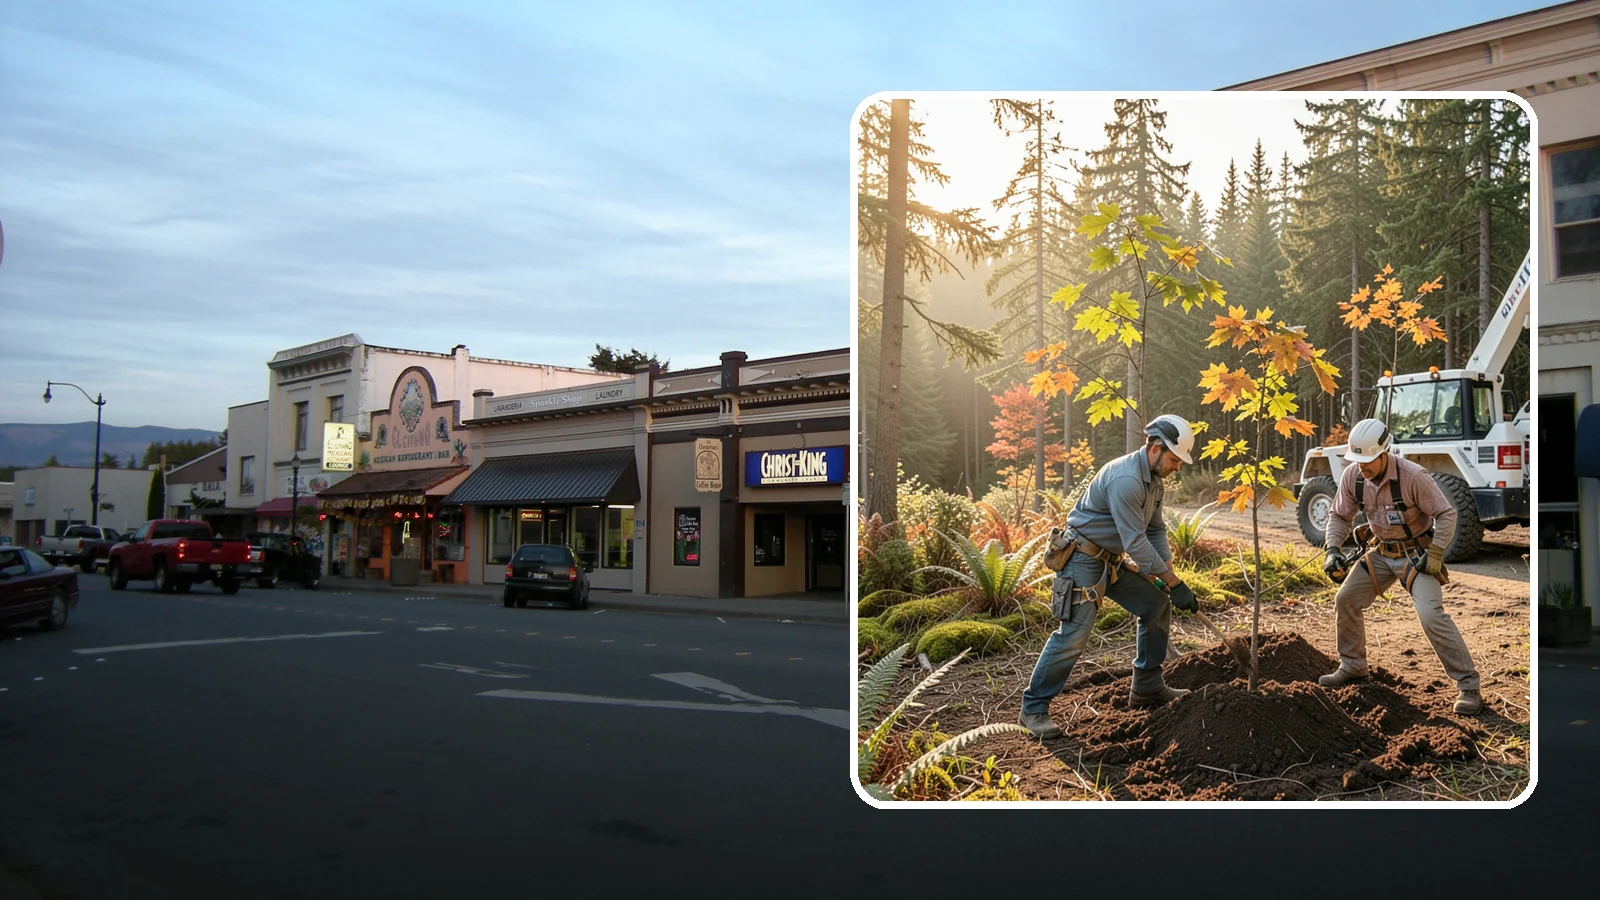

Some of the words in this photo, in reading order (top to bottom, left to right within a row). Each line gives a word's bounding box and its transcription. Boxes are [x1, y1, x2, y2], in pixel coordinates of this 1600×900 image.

[596, 389, 623, 400] LAUNDRY
[494, 402, 522, 412] LAVANDERIA
[373, 455, 396, 463] MEXICAN
[398, 452, 433, 462] RESTAURANT
[438, 451, 450, 459] BAR
[761, 452, 798, 478] CHRIST
[799, 450, 827, 476] KING
